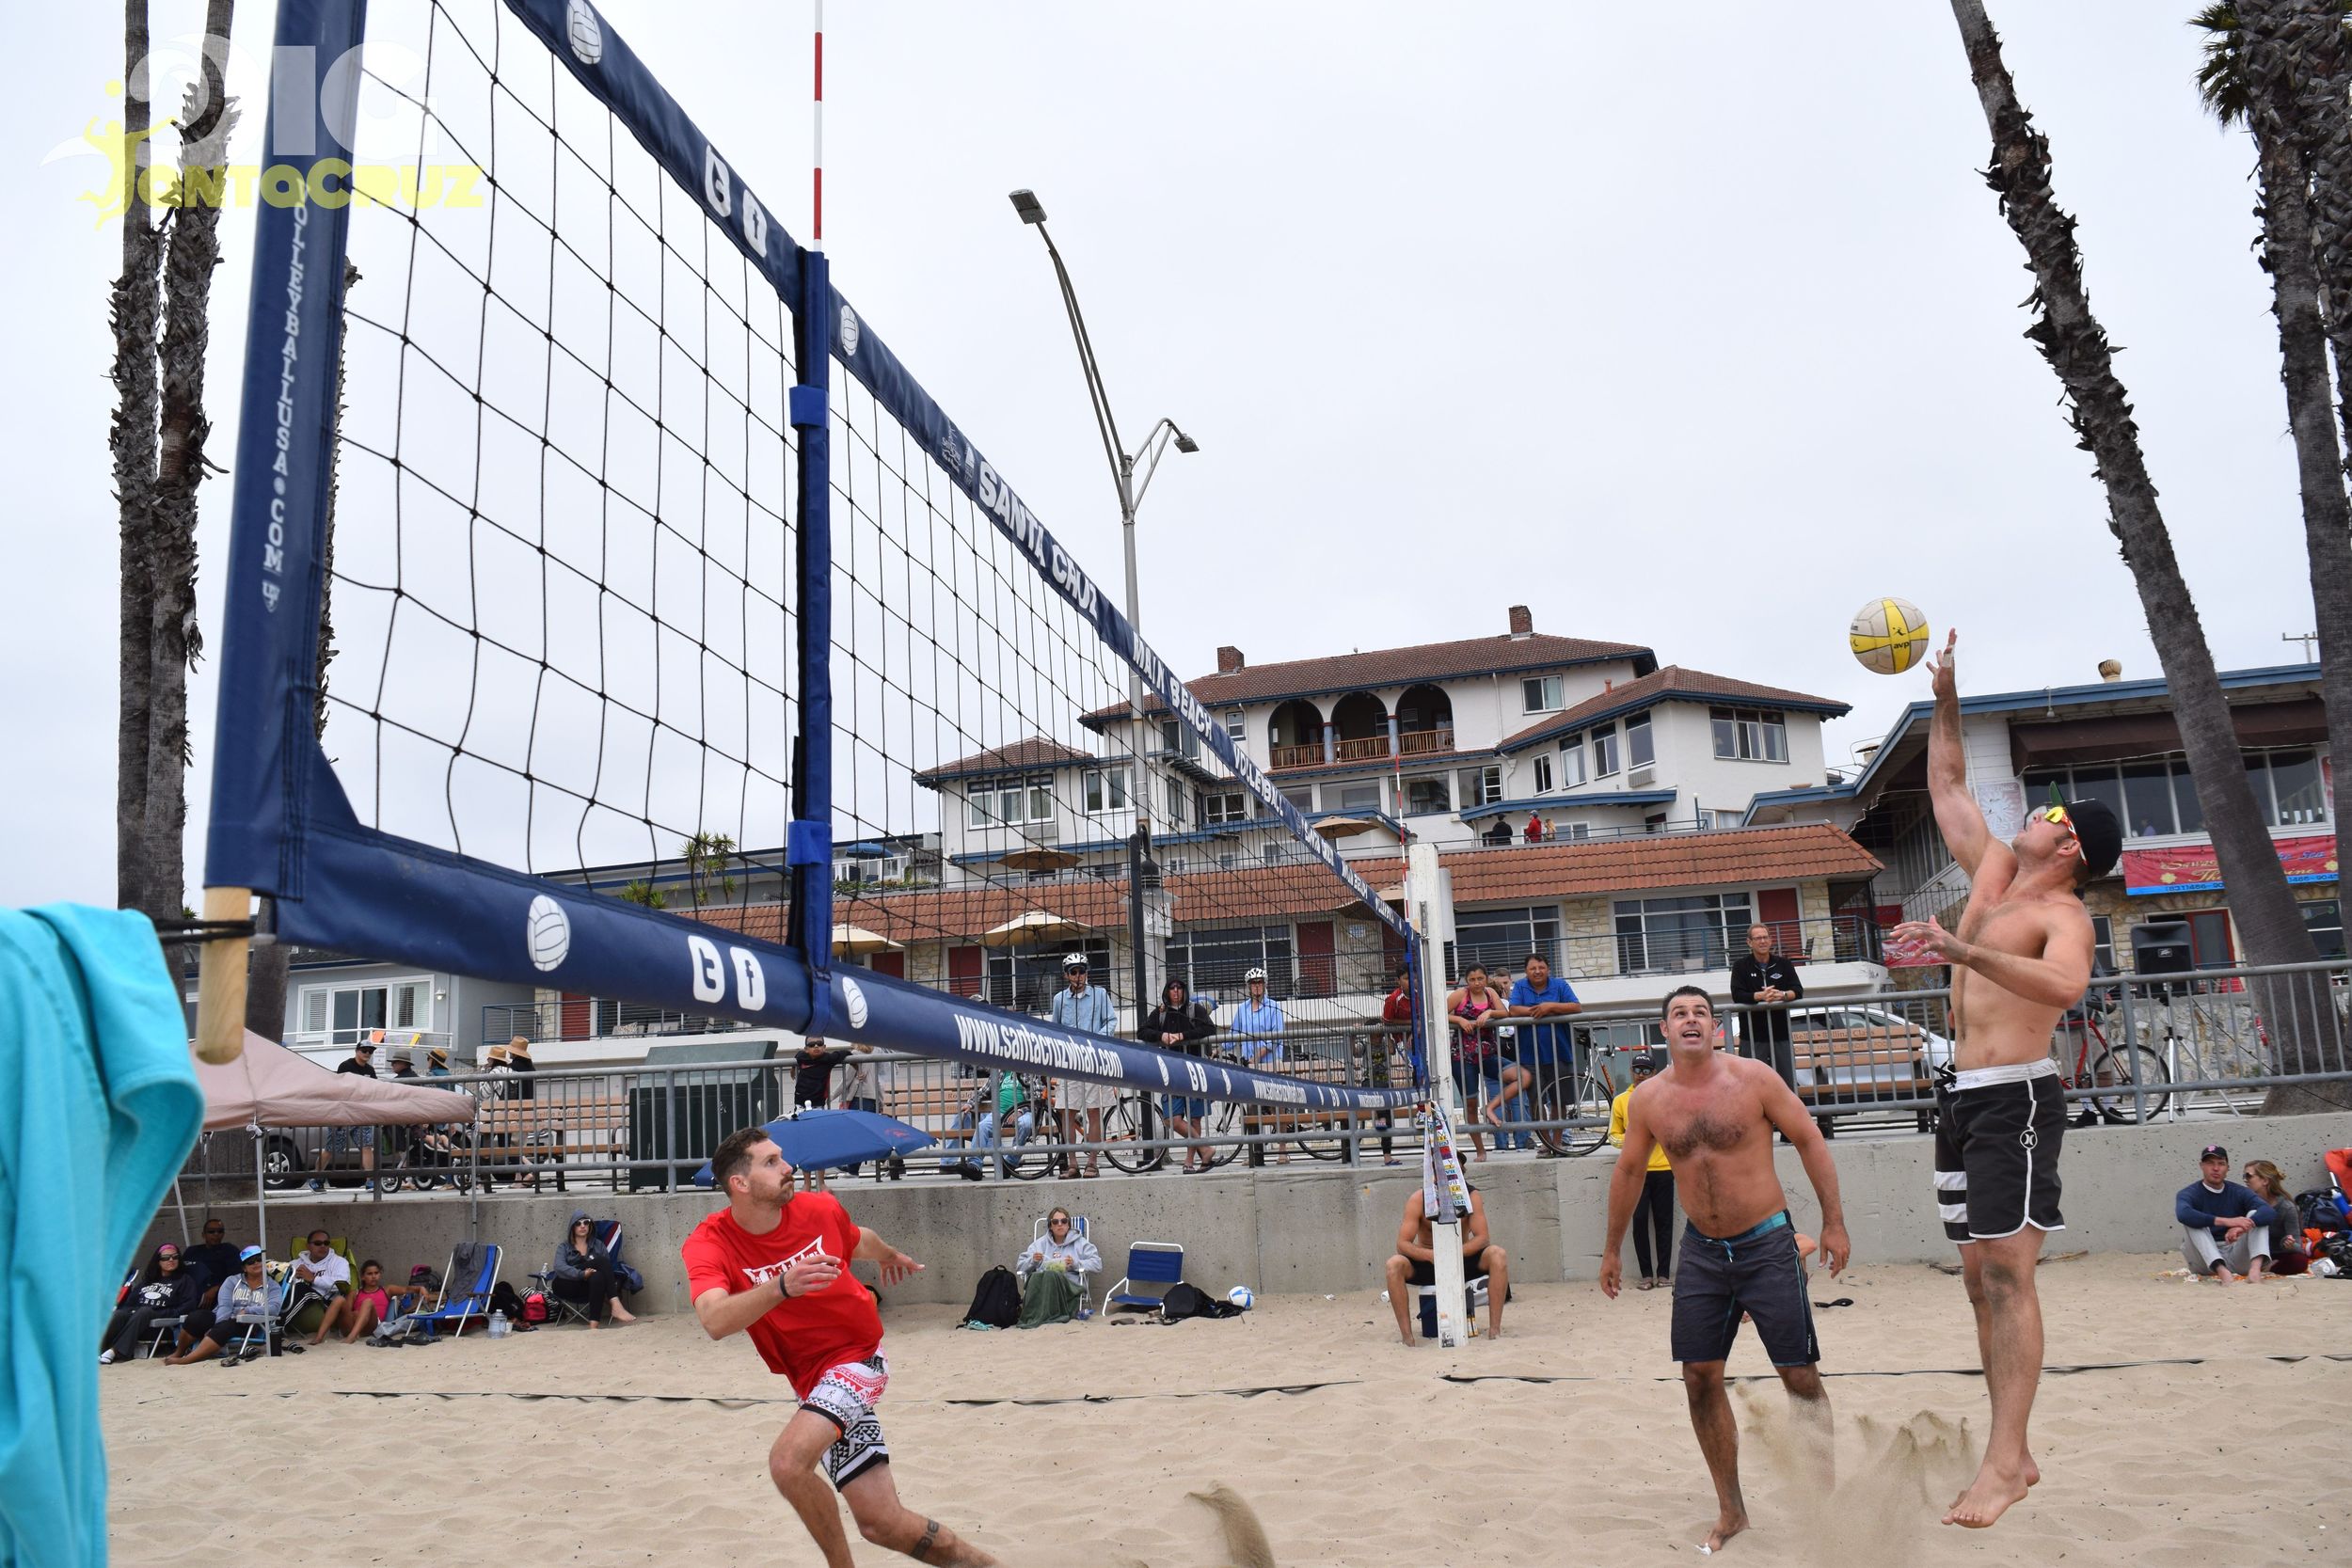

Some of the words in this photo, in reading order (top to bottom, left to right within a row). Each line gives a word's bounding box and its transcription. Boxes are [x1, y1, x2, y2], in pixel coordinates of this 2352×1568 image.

[979, 461, 1046, 568] SANTA
[1052, 544, 1098, 621] CRUZ
[1133, 631, 1166, 694] MAIN
[1169, 676, 1213, 741] BEACH
[1893, 641, 1910, 649] avp
[953, 1013, 1123, 1079] www.santacruzwharf.com
